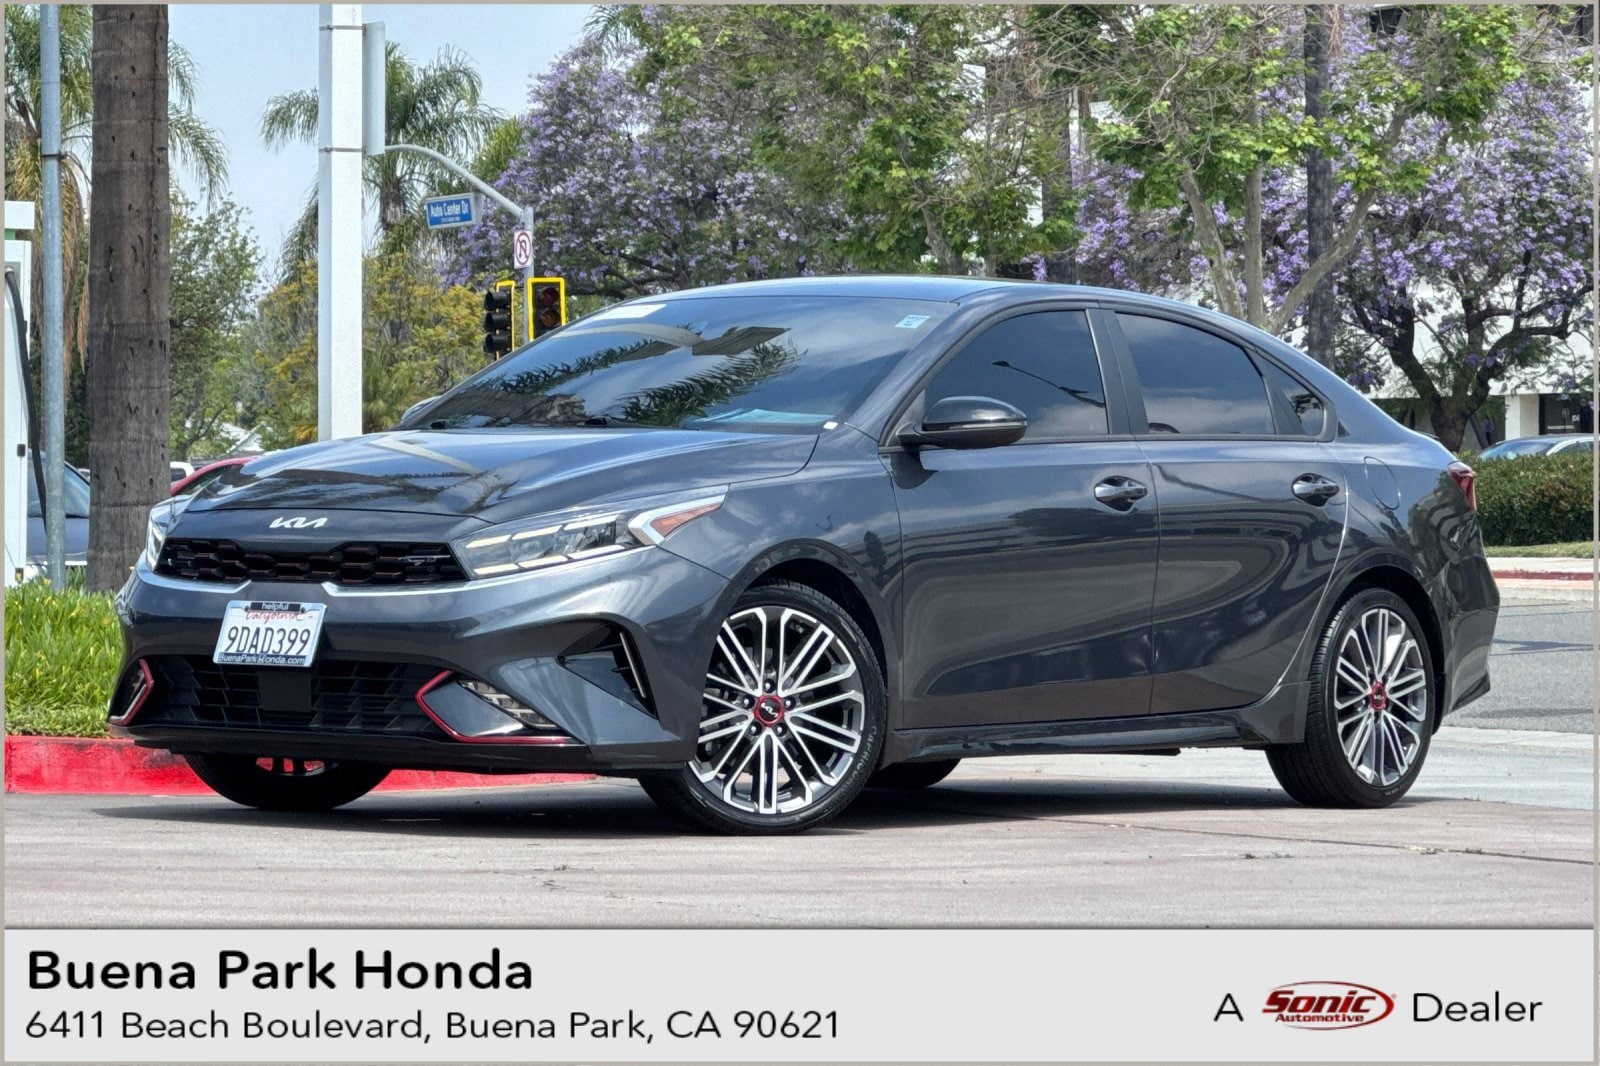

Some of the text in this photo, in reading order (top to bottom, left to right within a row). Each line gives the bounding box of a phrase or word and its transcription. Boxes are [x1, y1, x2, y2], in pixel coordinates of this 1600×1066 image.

[431, 200, 469, 217] Auto Center Dr
[269, 516, 328, 529] KIA
[261, 601, 289, 612] helpful
[224, 626, 311, 655] 9DAD399
